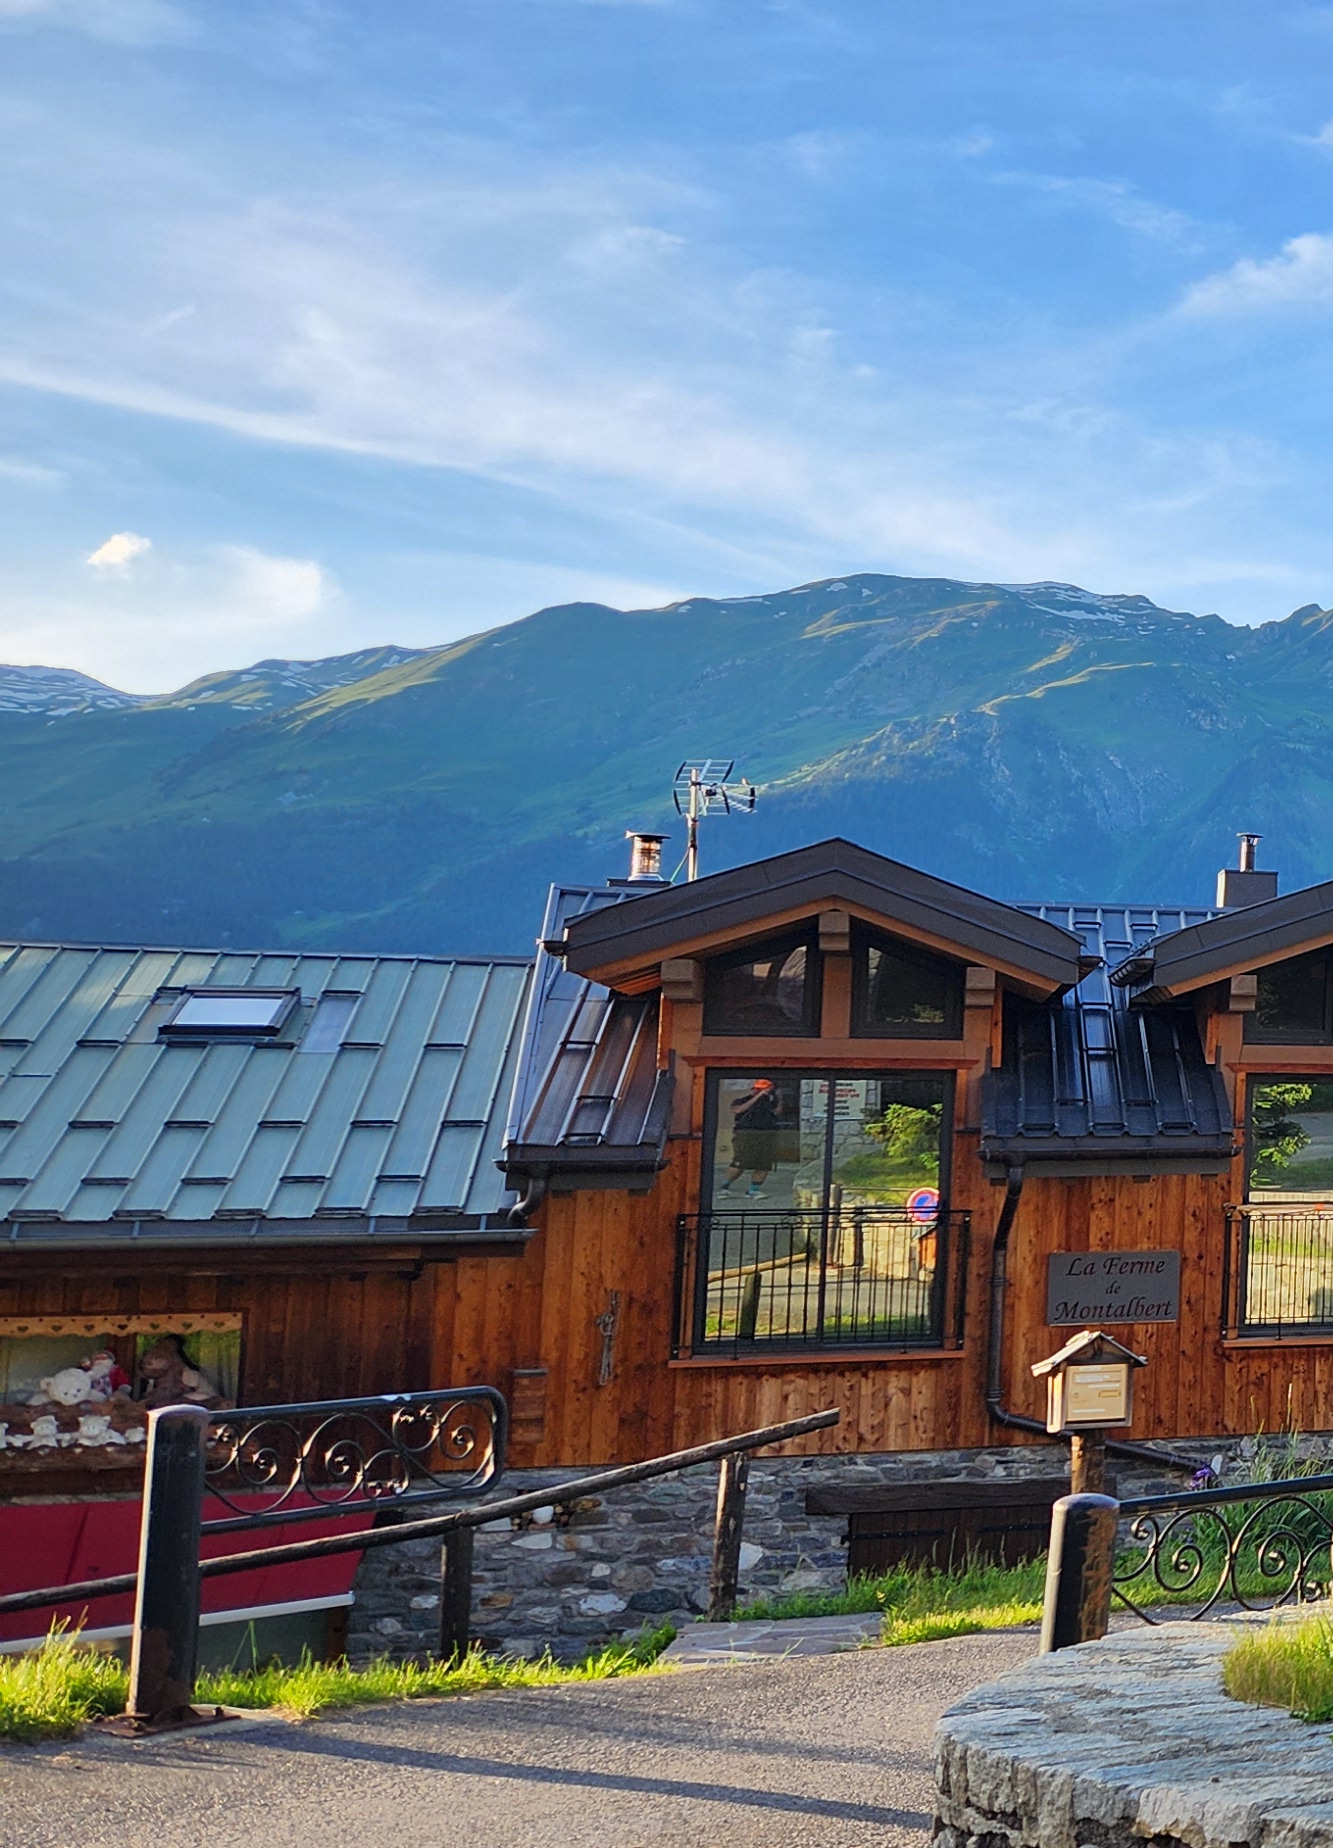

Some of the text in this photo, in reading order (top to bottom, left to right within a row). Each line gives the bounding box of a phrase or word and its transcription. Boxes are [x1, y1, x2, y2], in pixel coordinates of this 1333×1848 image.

[1066, 1256, 1166, 1277] La Ferme
[1105, 1280, 1121, 1295] de
[1053, 1296, 1172, 1321] Montalbert
